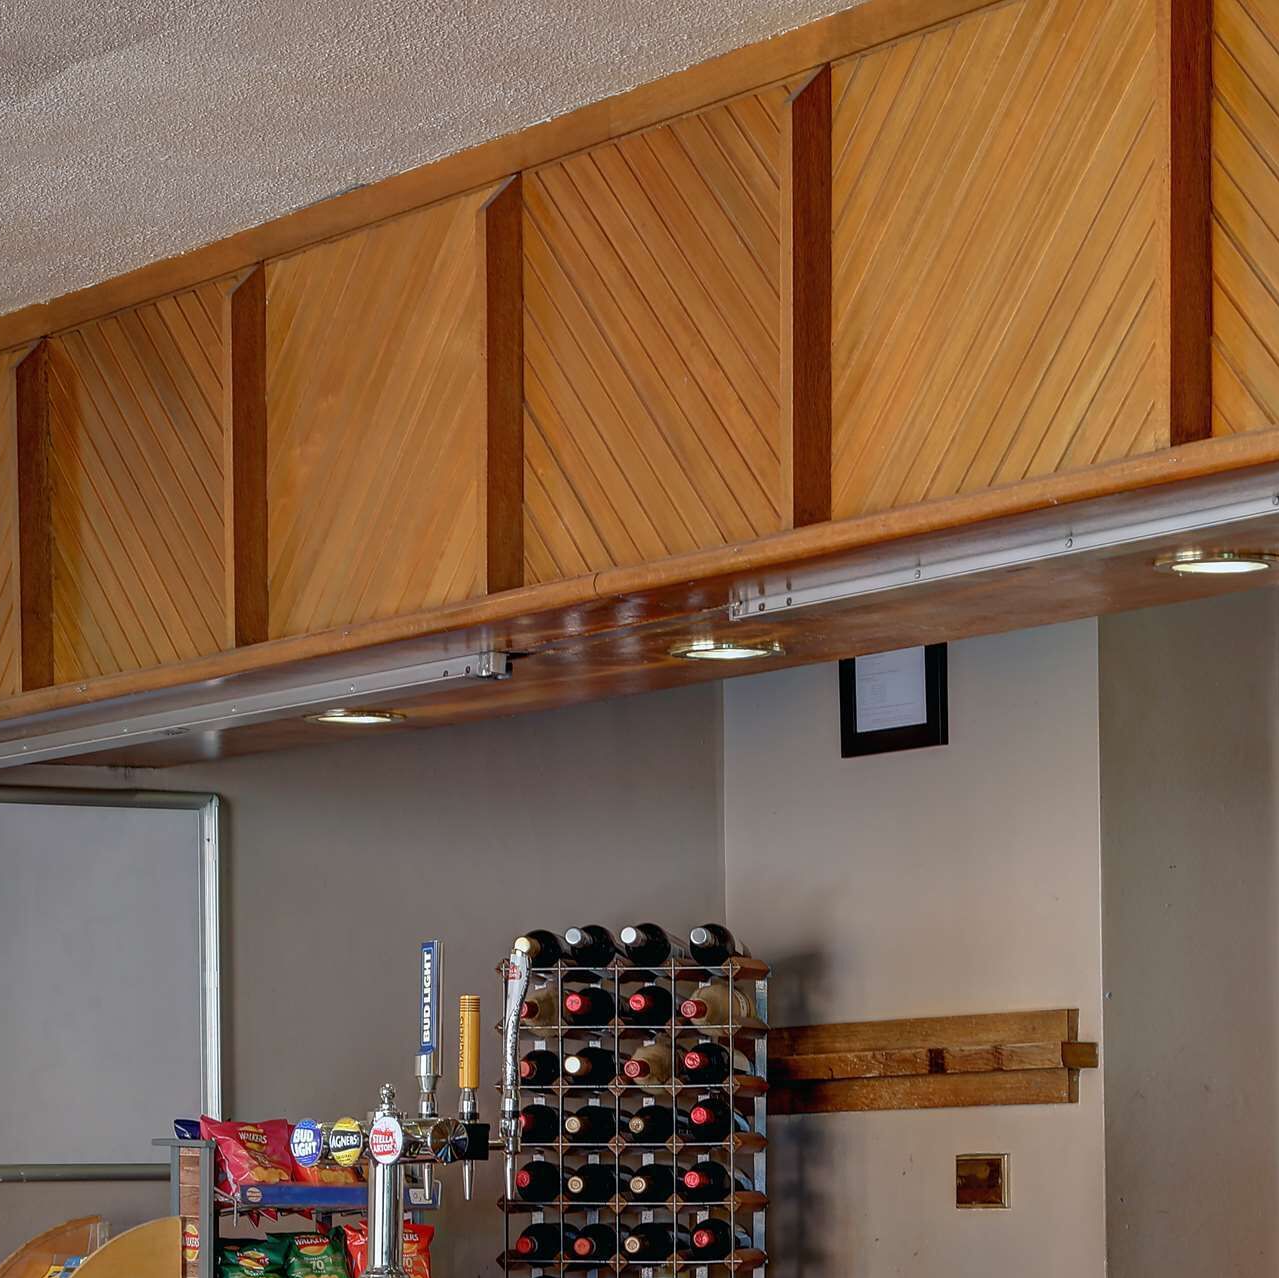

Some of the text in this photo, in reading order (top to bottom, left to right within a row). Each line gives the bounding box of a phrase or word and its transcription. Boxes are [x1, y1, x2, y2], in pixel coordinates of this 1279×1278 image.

[423, 951, 432, 1043] BUD LIGHT
[238, 1131, 268, 1144] WALKERS
[293, 1128, 314, 1143] BUD
[373, 1134, 393, 1143] STELLA
[290, 1141, 317, 1157] LIGHT
[373, 1143, 393, 1152] ARTOIS
[310, 1259, 324, 1270] 70
